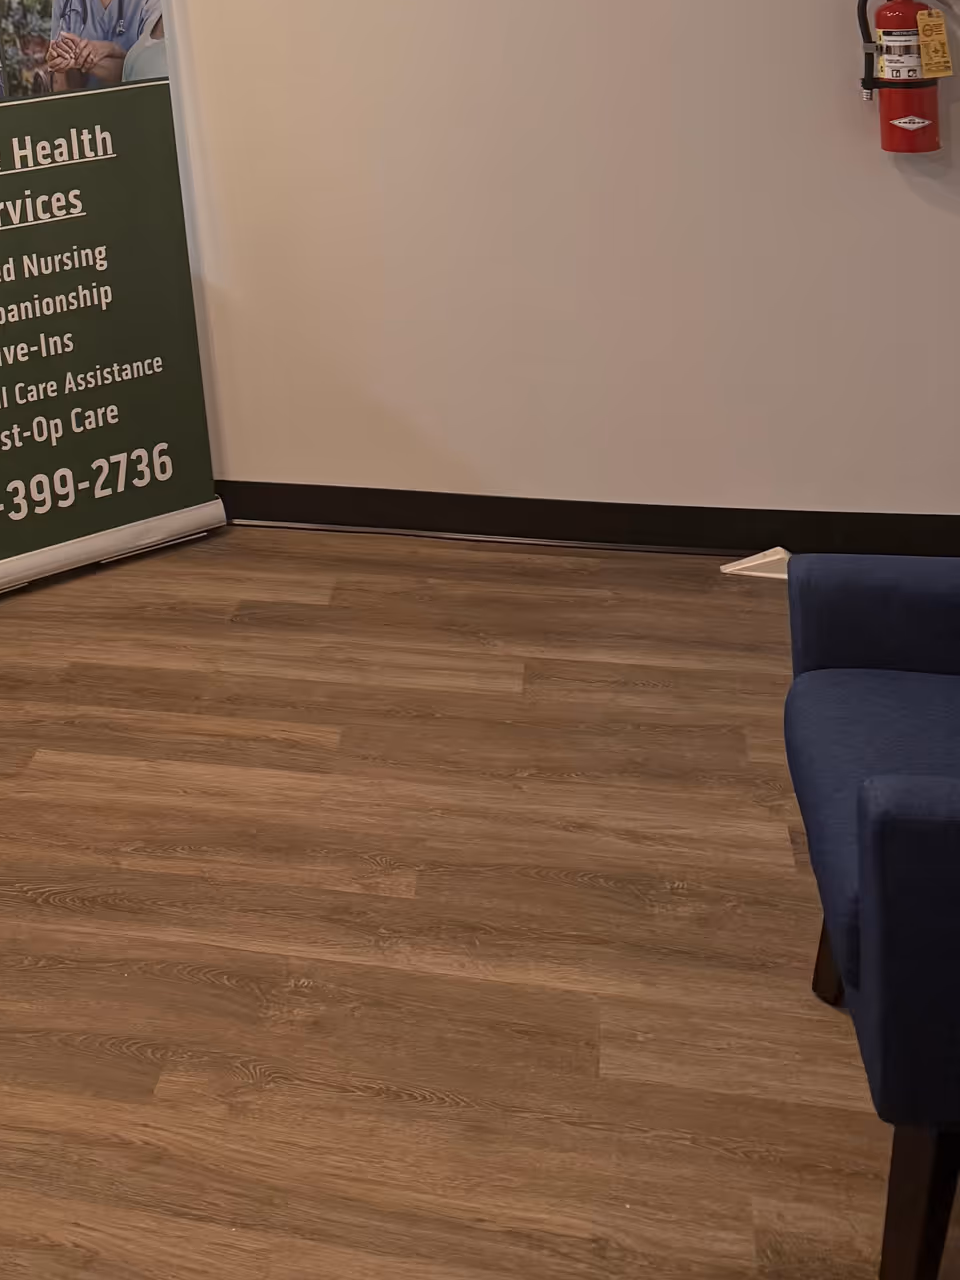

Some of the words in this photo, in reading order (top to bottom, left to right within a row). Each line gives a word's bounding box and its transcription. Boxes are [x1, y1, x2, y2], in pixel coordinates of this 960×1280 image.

[12, 124, 114, 169] Health
[23, 245, 108, 278] Nursing
[15, 380, 58, 405] Care
[64, 356, 163, 394] Assistance
[71, 404, 119, 433] Care
